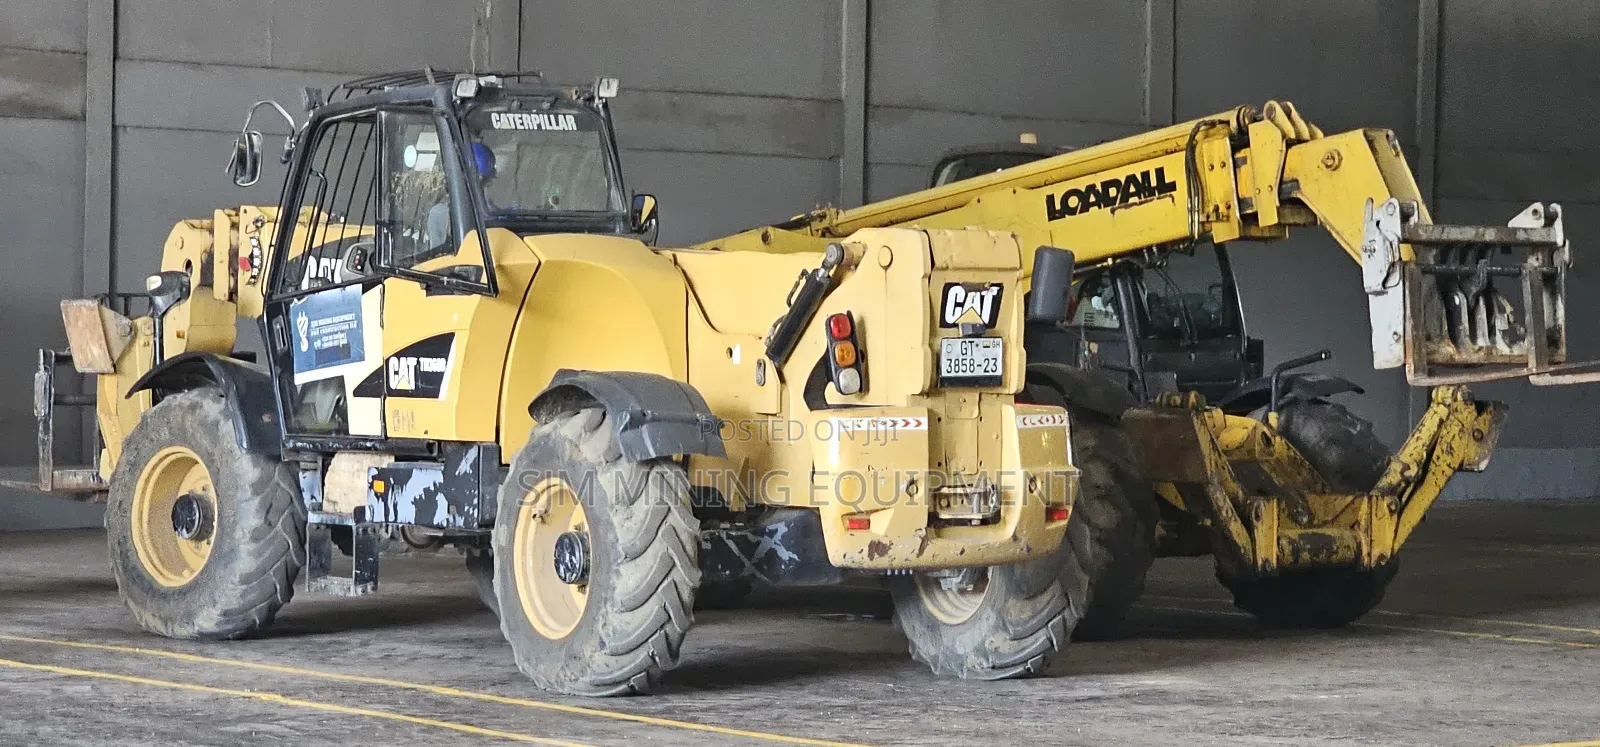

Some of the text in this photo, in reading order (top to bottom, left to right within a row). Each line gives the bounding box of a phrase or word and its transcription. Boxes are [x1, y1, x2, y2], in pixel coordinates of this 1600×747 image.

[491, 112, 577, 131] CATERPILLAR
[1045, 166, 1177, 222] LOADALL
[944, 285, 1000, 324] CAT
[960, 341, 1001, 356] GT GH
[388, 356, 418, 390] CAT
[946, 358, 998, 373] 3858-23
